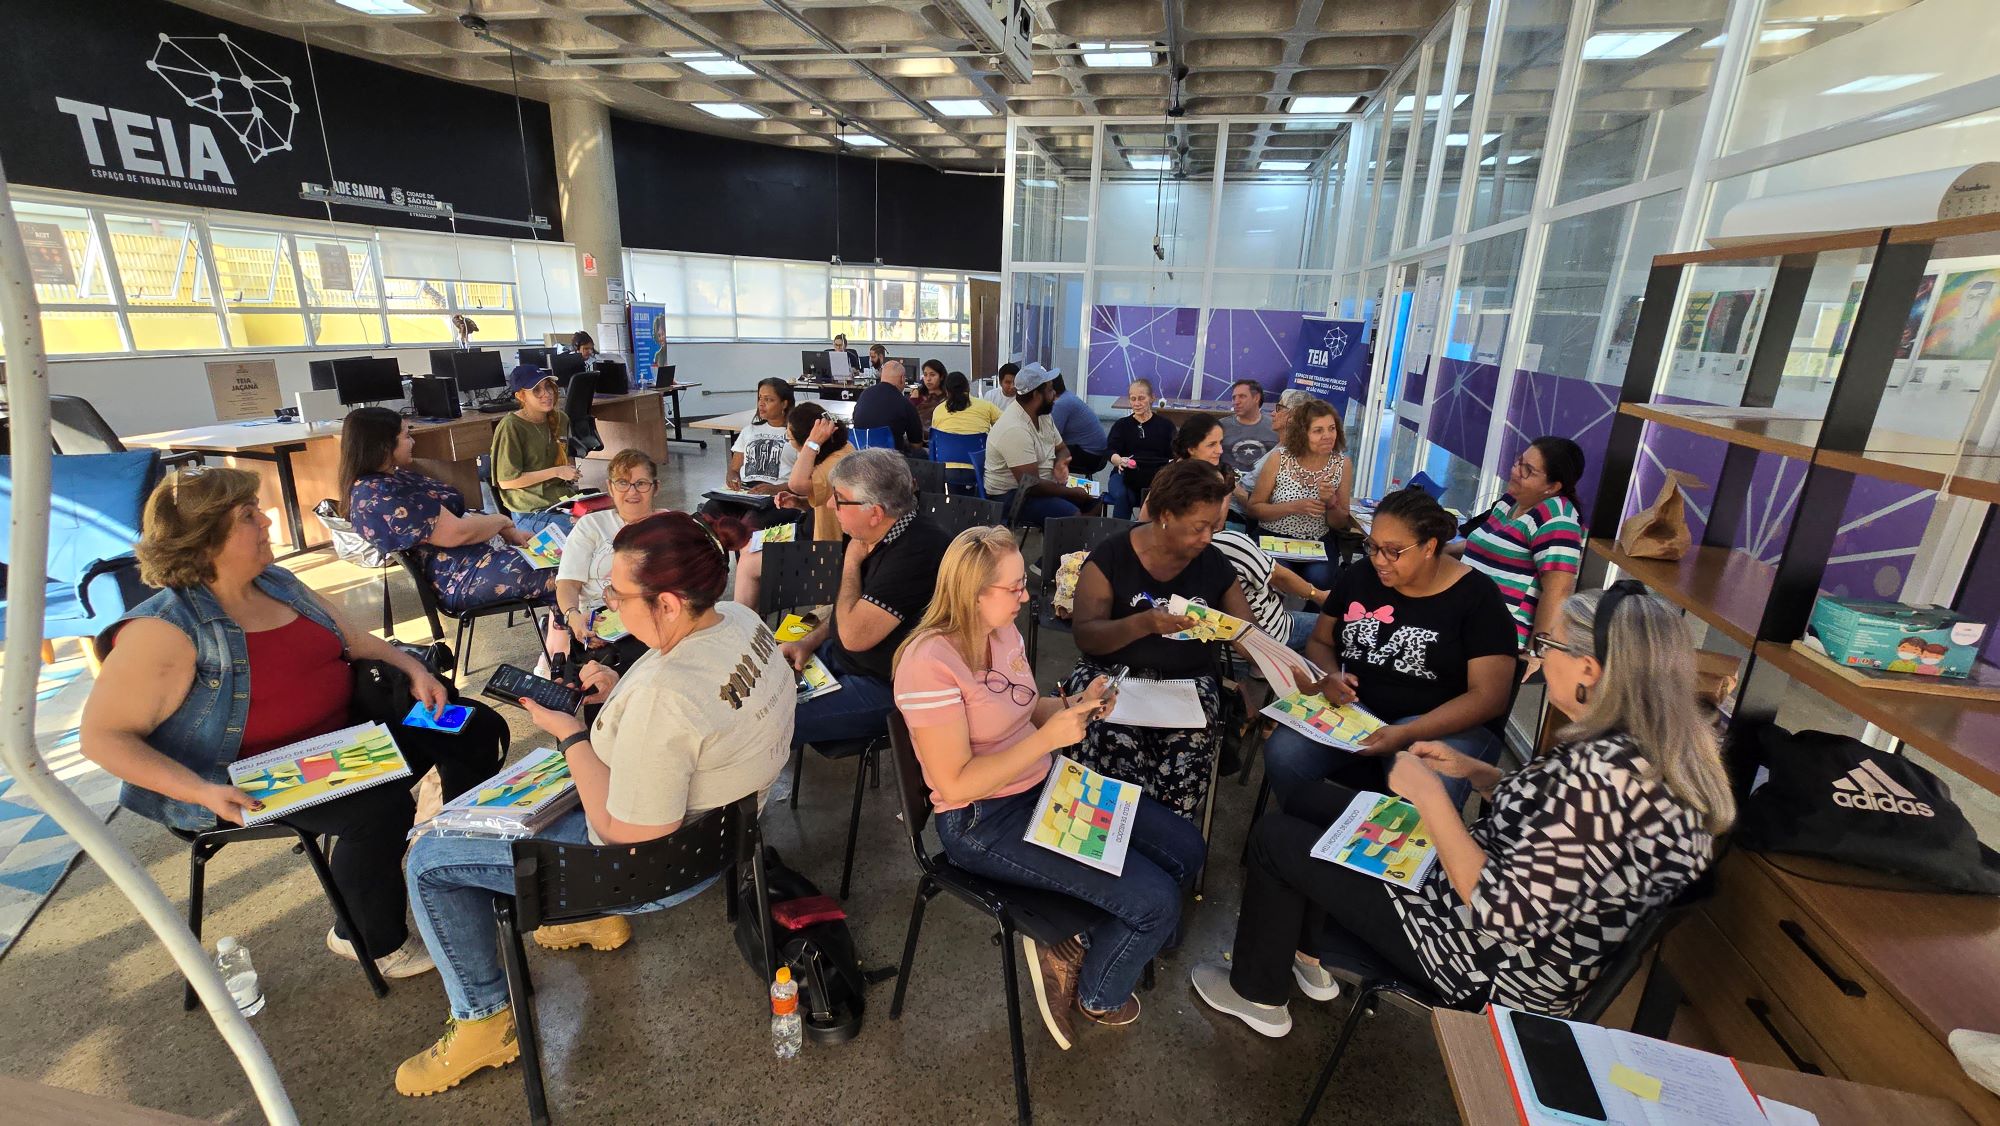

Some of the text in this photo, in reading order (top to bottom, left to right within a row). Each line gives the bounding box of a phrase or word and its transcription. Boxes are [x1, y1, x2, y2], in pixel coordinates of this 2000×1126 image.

[55, 96, 235, 185] TEIA
[91, 169, 238, 196] ESPAÇO DE TRABALHO COLABORATIVO
[352, 183, 386, 200] SAMPA
[406, 190, 426, 199] CIDADE
[407, 197, 422, 205] SÃO
[1307, 348, 1329, 367] TEIA
[232, 383, 259, 391] JAÇANÃ
[235, 764, 255, 772] MEU
[256, 754, 293, 770] MODELO
[294, 749, 306, 757] DE
[1832, 791, 1936, 818] adidas
